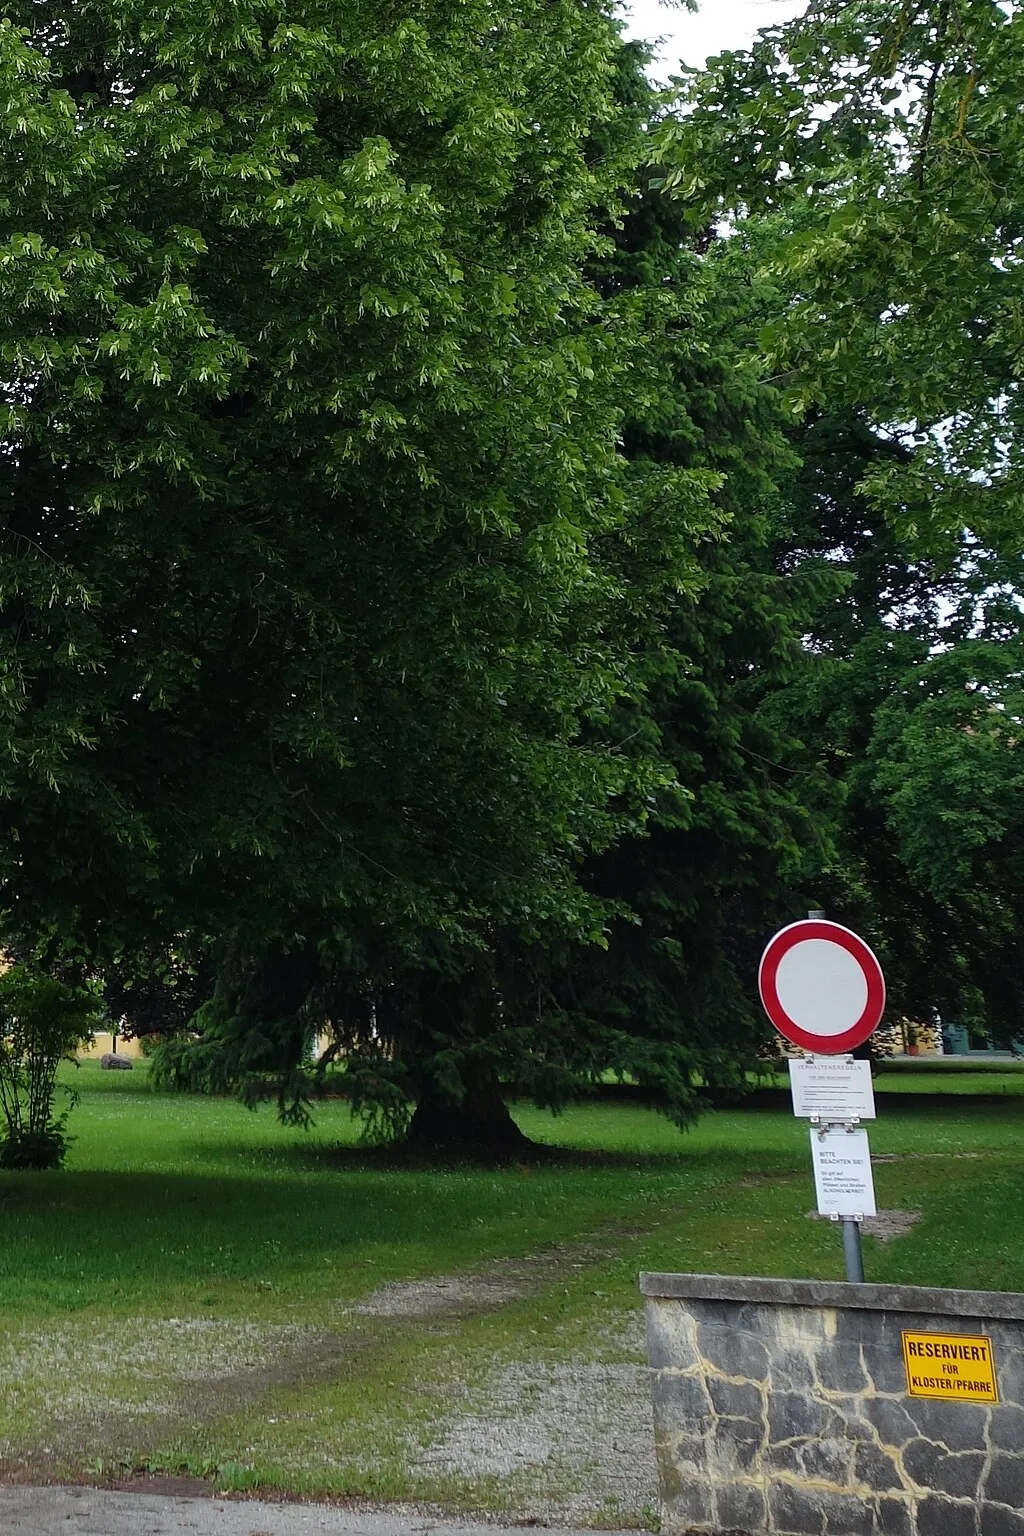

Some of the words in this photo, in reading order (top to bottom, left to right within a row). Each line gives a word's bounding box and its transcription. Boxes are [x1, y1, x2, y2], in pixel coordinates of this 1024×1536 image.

[908, 1342, 987, 1362] RESERVIERT
[942, 1362, 959, 1375] FÜR
[911, 1376, 992, 1393] KLOSTER/PFARRE
